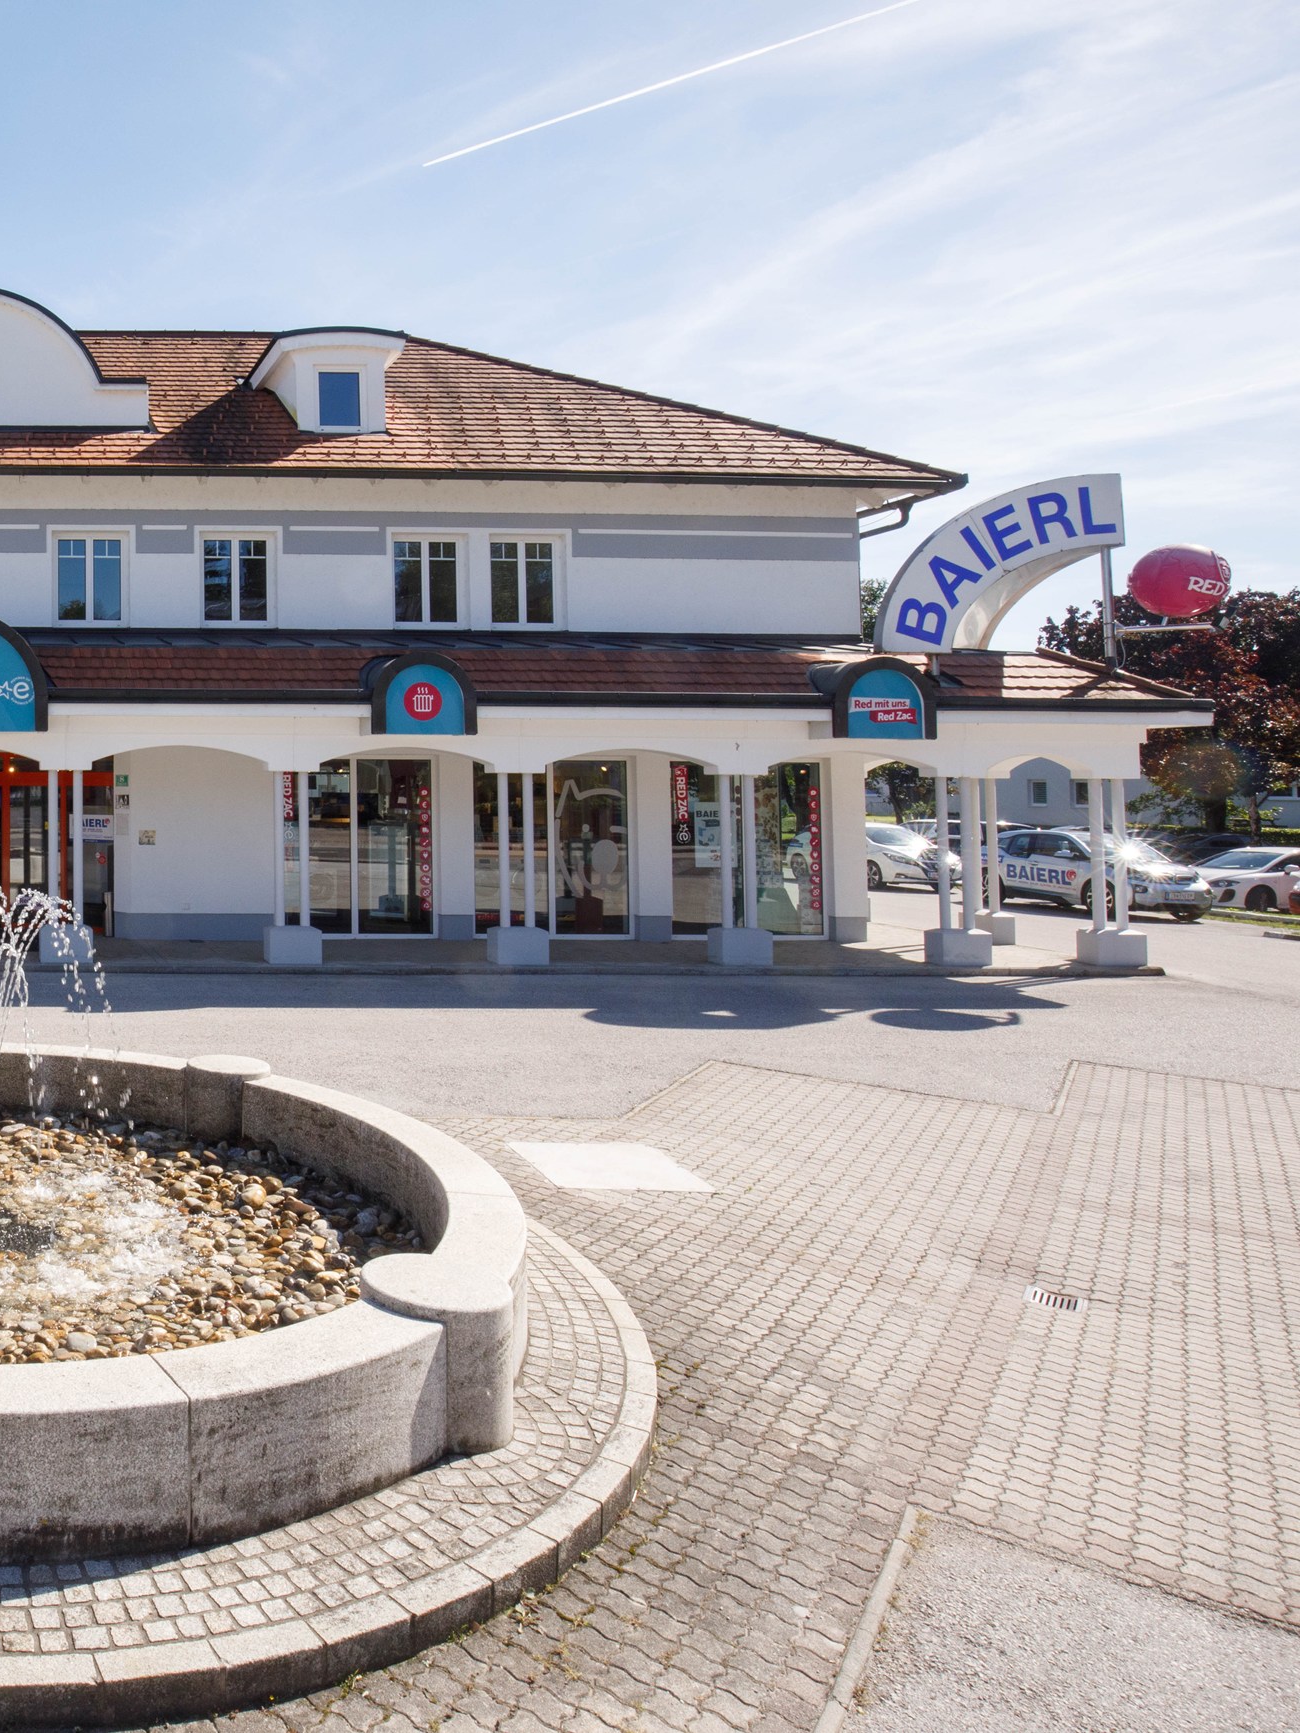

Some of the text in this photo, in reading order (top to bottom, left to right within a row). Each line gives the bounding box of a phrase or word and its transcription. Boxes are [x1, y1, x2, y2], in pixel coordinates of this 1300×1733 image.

[895, 486, 1117, 646] BAIERL
[1187, 576, 1225, 597] RED
[854, 699, 872, 709] Red
[874, 699, 890, 708] mit
[877, 711, 914, 721] Red Zac.
[283, 774, 293, 818] RED ZAC
[676, 776, 688, 820] RED ZAC
[696, 810, 719, 818] BAIE
[1006, 863, 1072, 886] BAIERL
